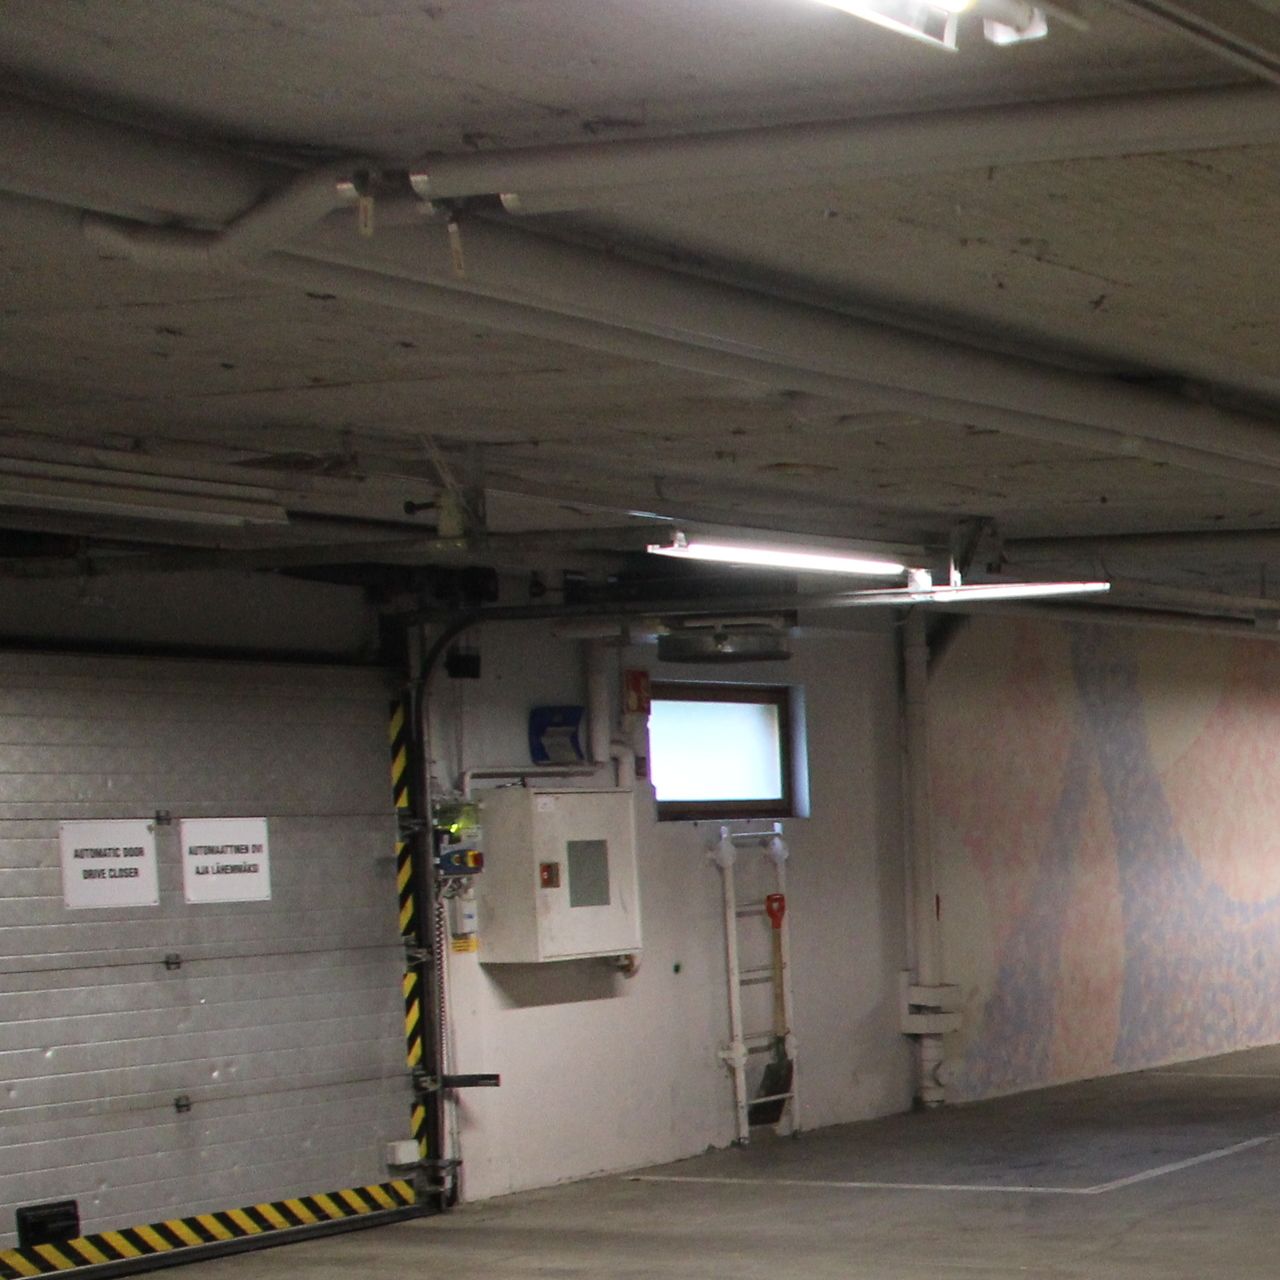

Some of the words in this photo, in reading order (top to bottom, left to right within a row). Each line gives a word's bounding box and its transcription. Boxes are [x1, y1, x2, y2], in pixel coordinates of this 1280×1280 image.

[73, 847, 121, 859] AUTOMATIC
[123, 846, 145, 858] DOOR
[82, 868, 107, 880] DRIVE
[108, 867, 140, 879] CLOSER
